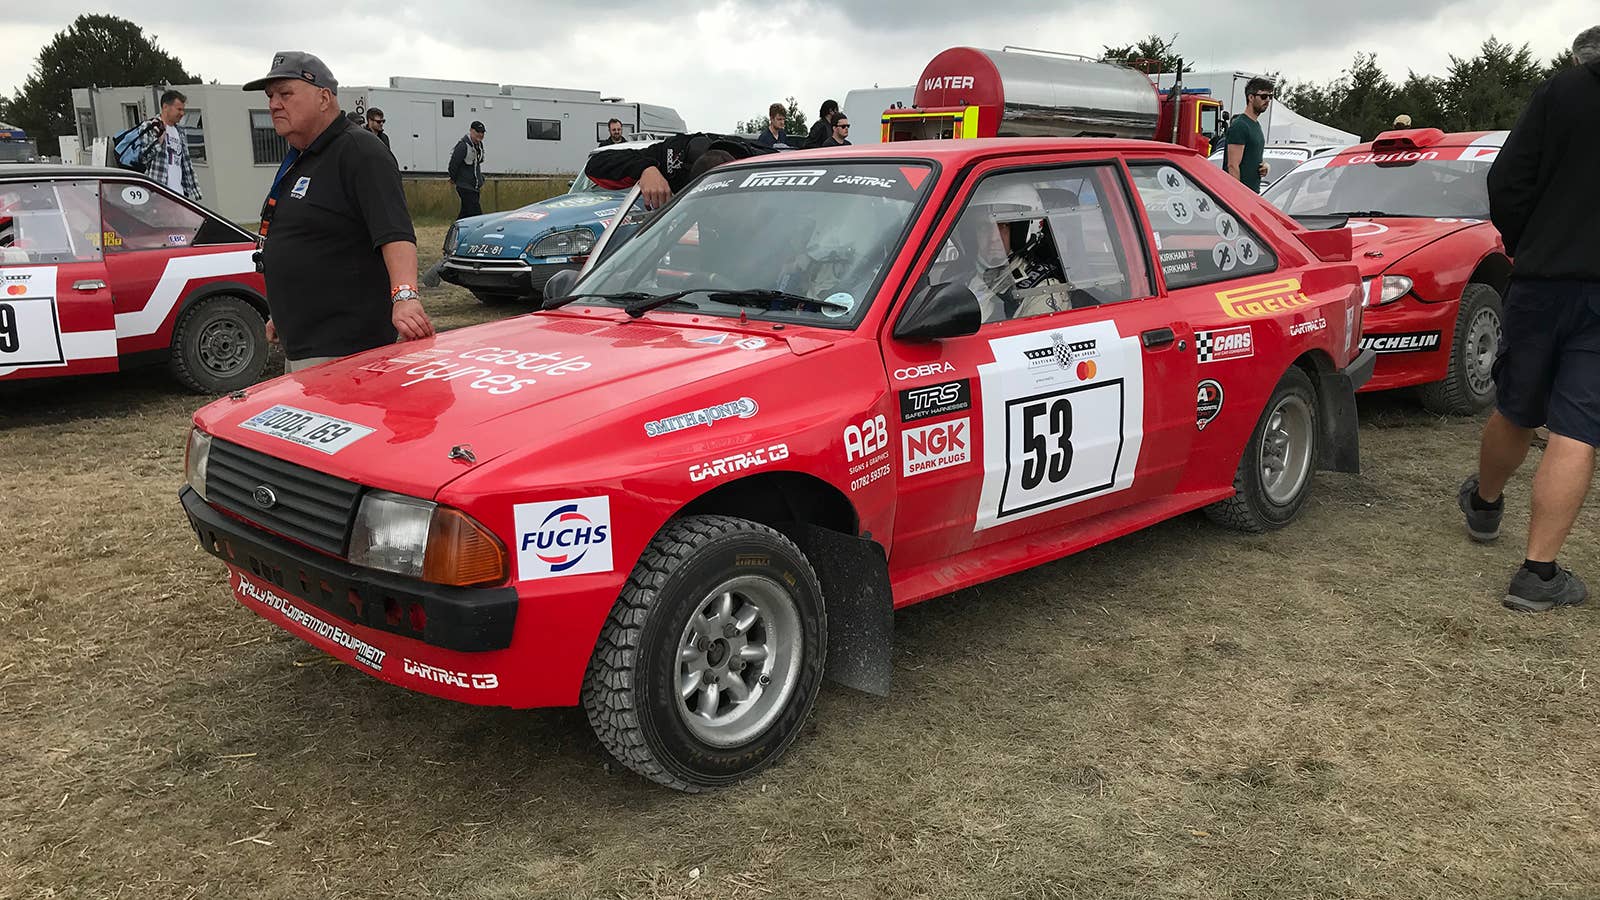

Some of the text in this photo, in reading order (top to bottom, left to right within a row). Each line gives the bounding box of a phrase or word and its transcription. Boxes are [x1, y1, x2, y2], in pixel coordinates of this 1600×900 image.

[924, 76, 974, 91] WATER
[739, 170, 828, 188] PIRELLI
[129, 191, 142, 200] 99
[1173, 202, 1187, 218] 53
[1163, 262, 1190, 274] KIRKHAM
[1215, 278, 1316, 318] PIRELLI
[1214, 332, 1251, 352] CARS
[458, 347, 592, 375] castle
[894, 361, 956, 380] COBRA
[401, 359, 537, 394] tyres
[908, 383, 962, 410] TRS
[905, 402, 968, 420] SAFETY HARNESSES
[843, 414, 888, 463] A2B
[907, 422, 966, 461] NGK
[1021, 398, 1074, 490] 53
[849, 462, 865, 475] SIGNS
[869, 451, 889, 466] GRAPHICS
[909, 452, 966, 473] SPARK PLUGS
[850, 464, 891, 492] 01782 593725
[521, 525, 608, 551] FUCHS
